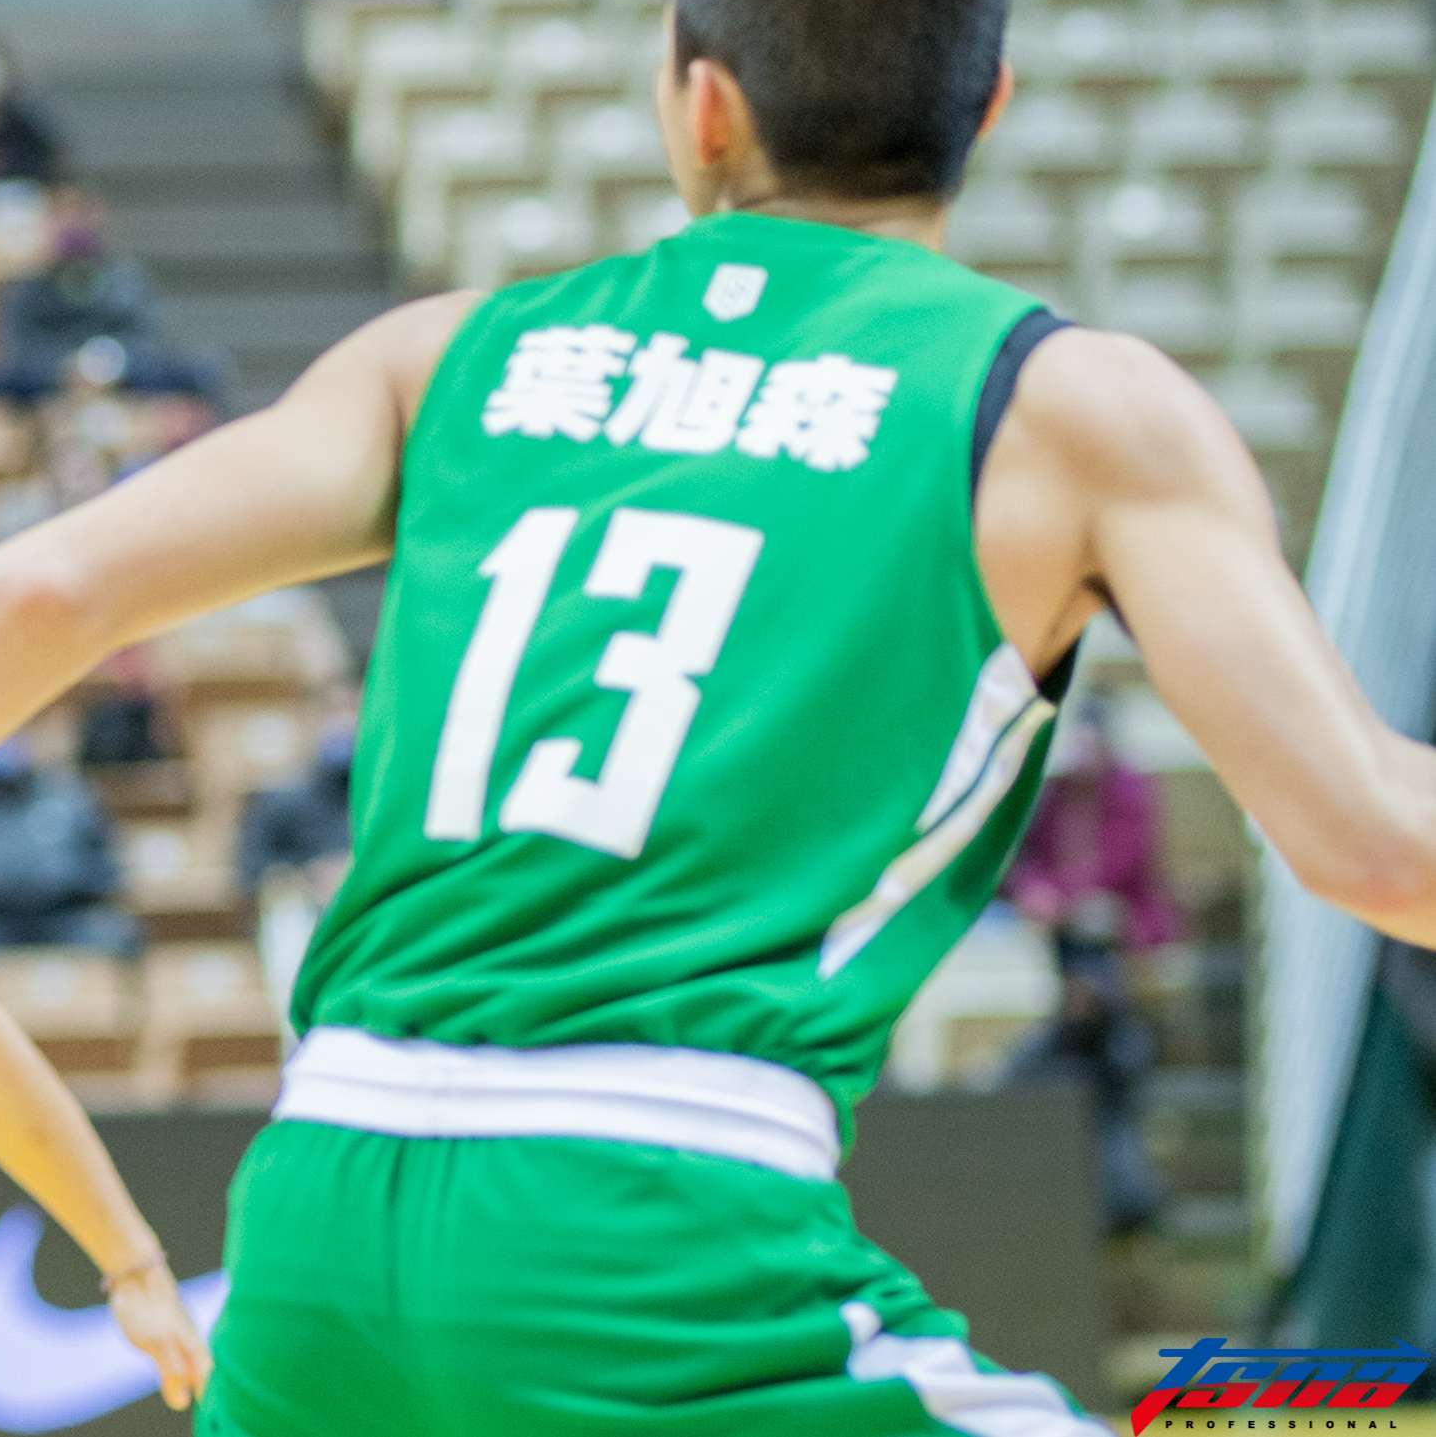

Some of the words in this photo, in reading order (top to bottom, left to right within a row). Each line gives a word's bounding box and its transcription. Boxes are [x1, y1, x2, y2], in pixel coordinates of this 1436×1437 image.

[481, 323, 899, 471] 葉旭森
[423, 506, 765, 861] 13
